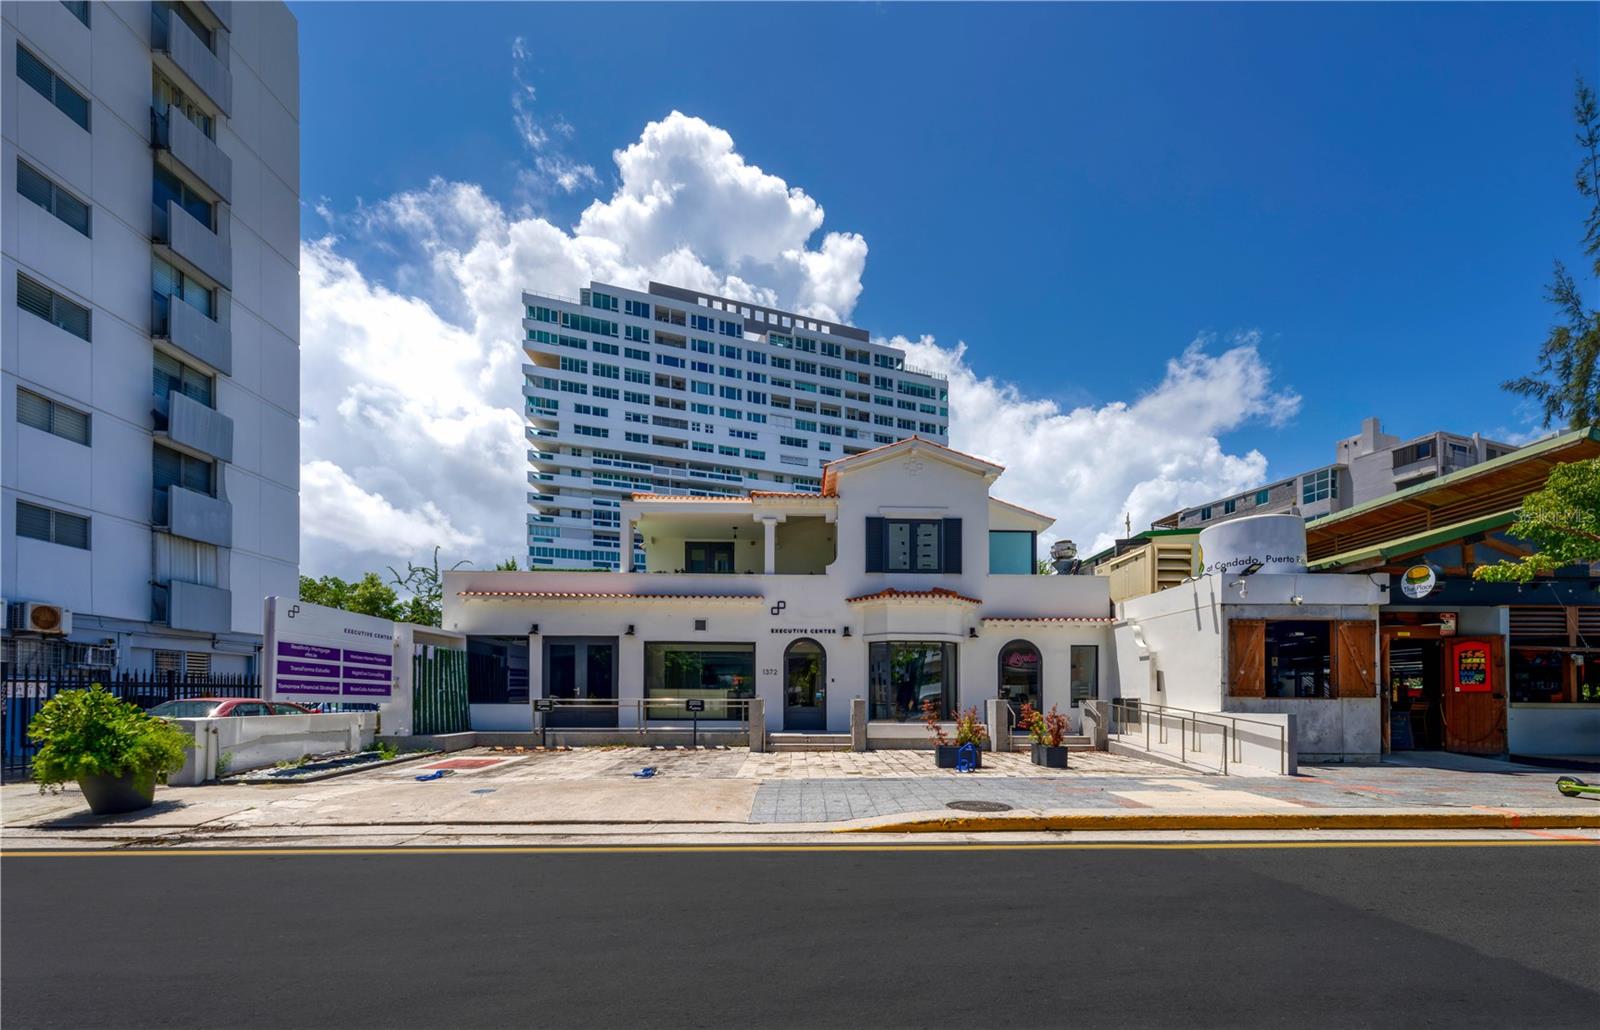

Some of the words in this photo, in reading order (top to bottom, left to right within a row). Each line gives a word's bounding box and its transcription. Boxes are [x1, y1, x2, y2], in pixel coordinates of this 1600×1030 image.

[1266, 554, 1295, 563] Puerto
[1403, 585, 1415, 593] The
[1416, 583, 1433, 591] Place
[344, 628, 373, 637] EXECUTIVE
[373, 632, 393, 640] CENTER
[762, 668, 778, 676] 1372
